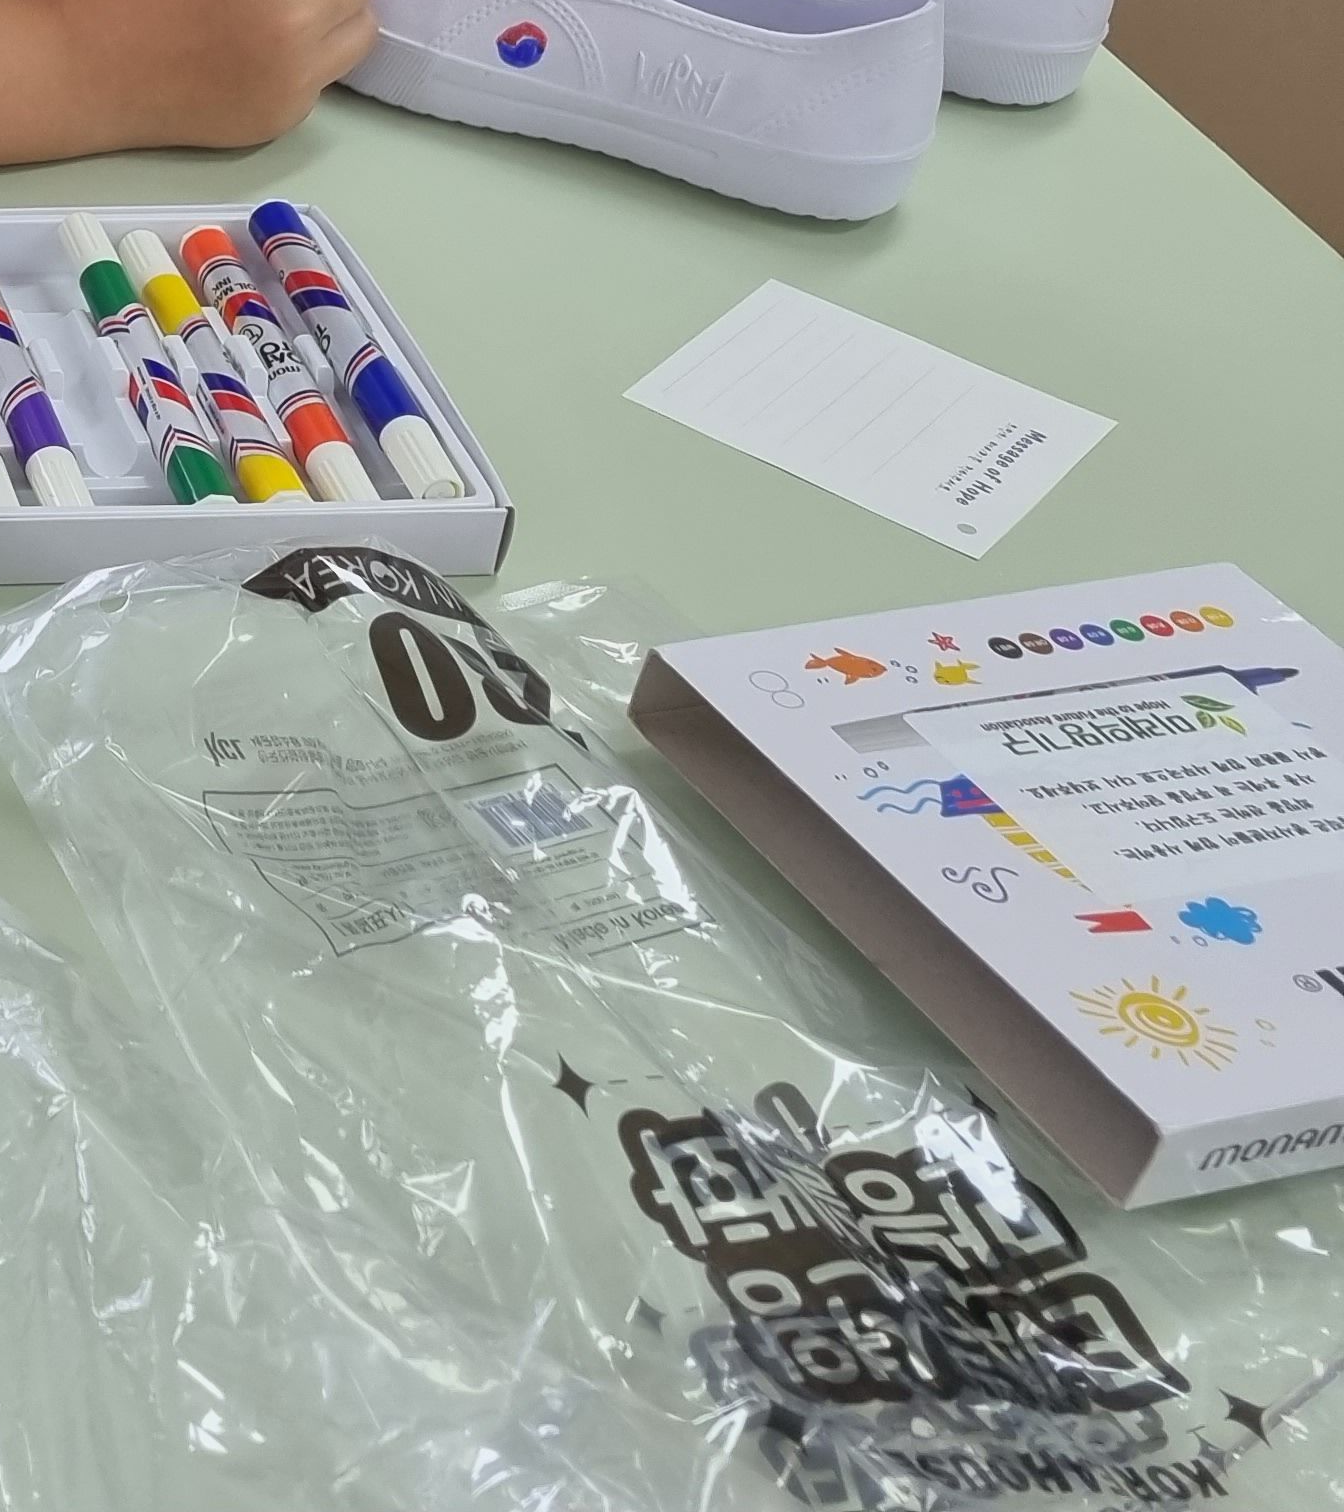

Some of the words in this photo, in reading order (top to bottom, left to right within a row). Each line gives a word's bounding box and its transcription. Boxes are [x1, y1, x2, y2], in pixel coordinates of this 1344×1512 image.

[995, 429, 1048, 468] Message
[956, 479, 994, 506] Hope
[983, 467, 1003, 485] of
[1002, 712, 1198, 756] 미래희망기구
